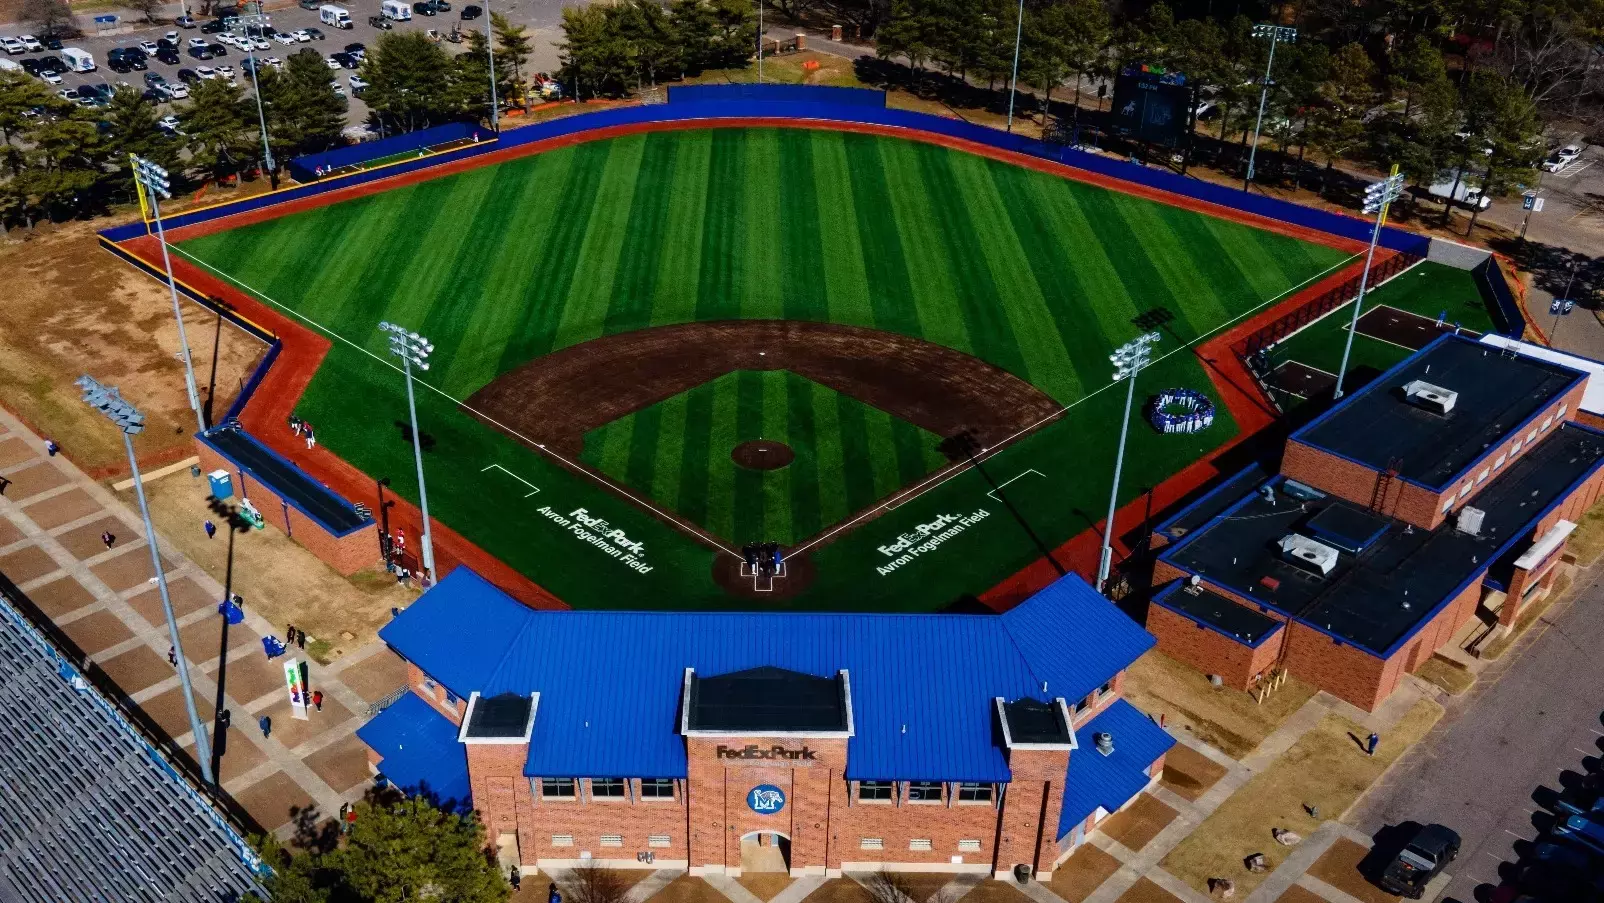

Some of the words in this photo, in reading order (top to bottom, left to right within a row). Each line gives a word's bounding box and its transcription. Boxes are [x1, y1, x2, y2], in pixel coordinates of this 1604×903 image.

[536, 506, 571, 527] Avron
[568, 523, 621, 558] Fogelman
[620, 553, 654, 574] Field
[876, 553, 914, 576] Avron
[908, 524, 965, 557] Fogelman
[959, 508, 991, 527] Field
[716, 744, 817, 760] FedExPark
